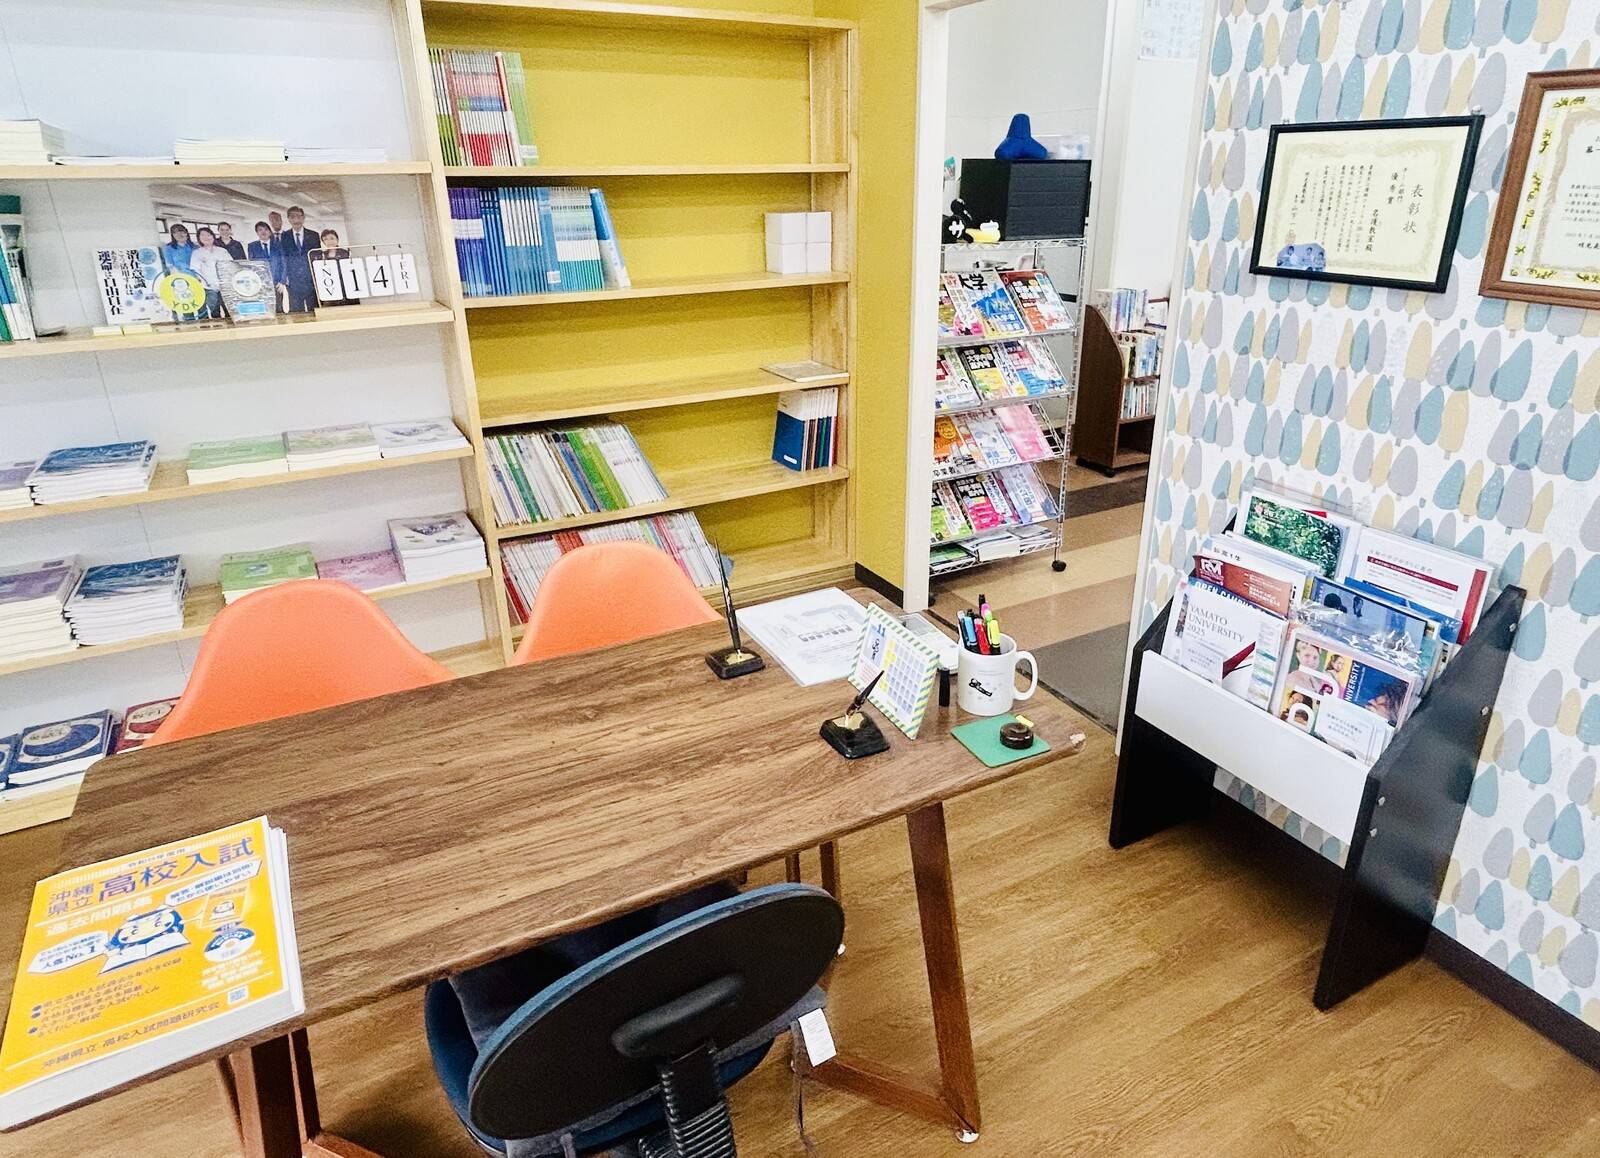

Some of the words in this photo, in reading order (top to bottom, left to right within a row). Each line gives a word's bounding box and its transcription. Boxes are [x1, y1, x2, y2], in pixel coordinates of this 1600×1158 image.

[1402, 183, 1425, 234] 表彰状
[97, 249, 121, 316] 運命は自由自在
[321, 268, 334, 296] NOV
[172, 300, 199, 312] YDK
[1187, 612, 1246, 643] UNIVERSITY
[1188, 603, 1229, 626] YAMATO
[1186, 624, 1206, 637] 2025
[1344, 661, 1359, 701] NIVERSITY
[98, 836, 255, 903] 高校入試
[47, 895, 92, 917] 県立
[49, 882, 94, 905] 沖縄
